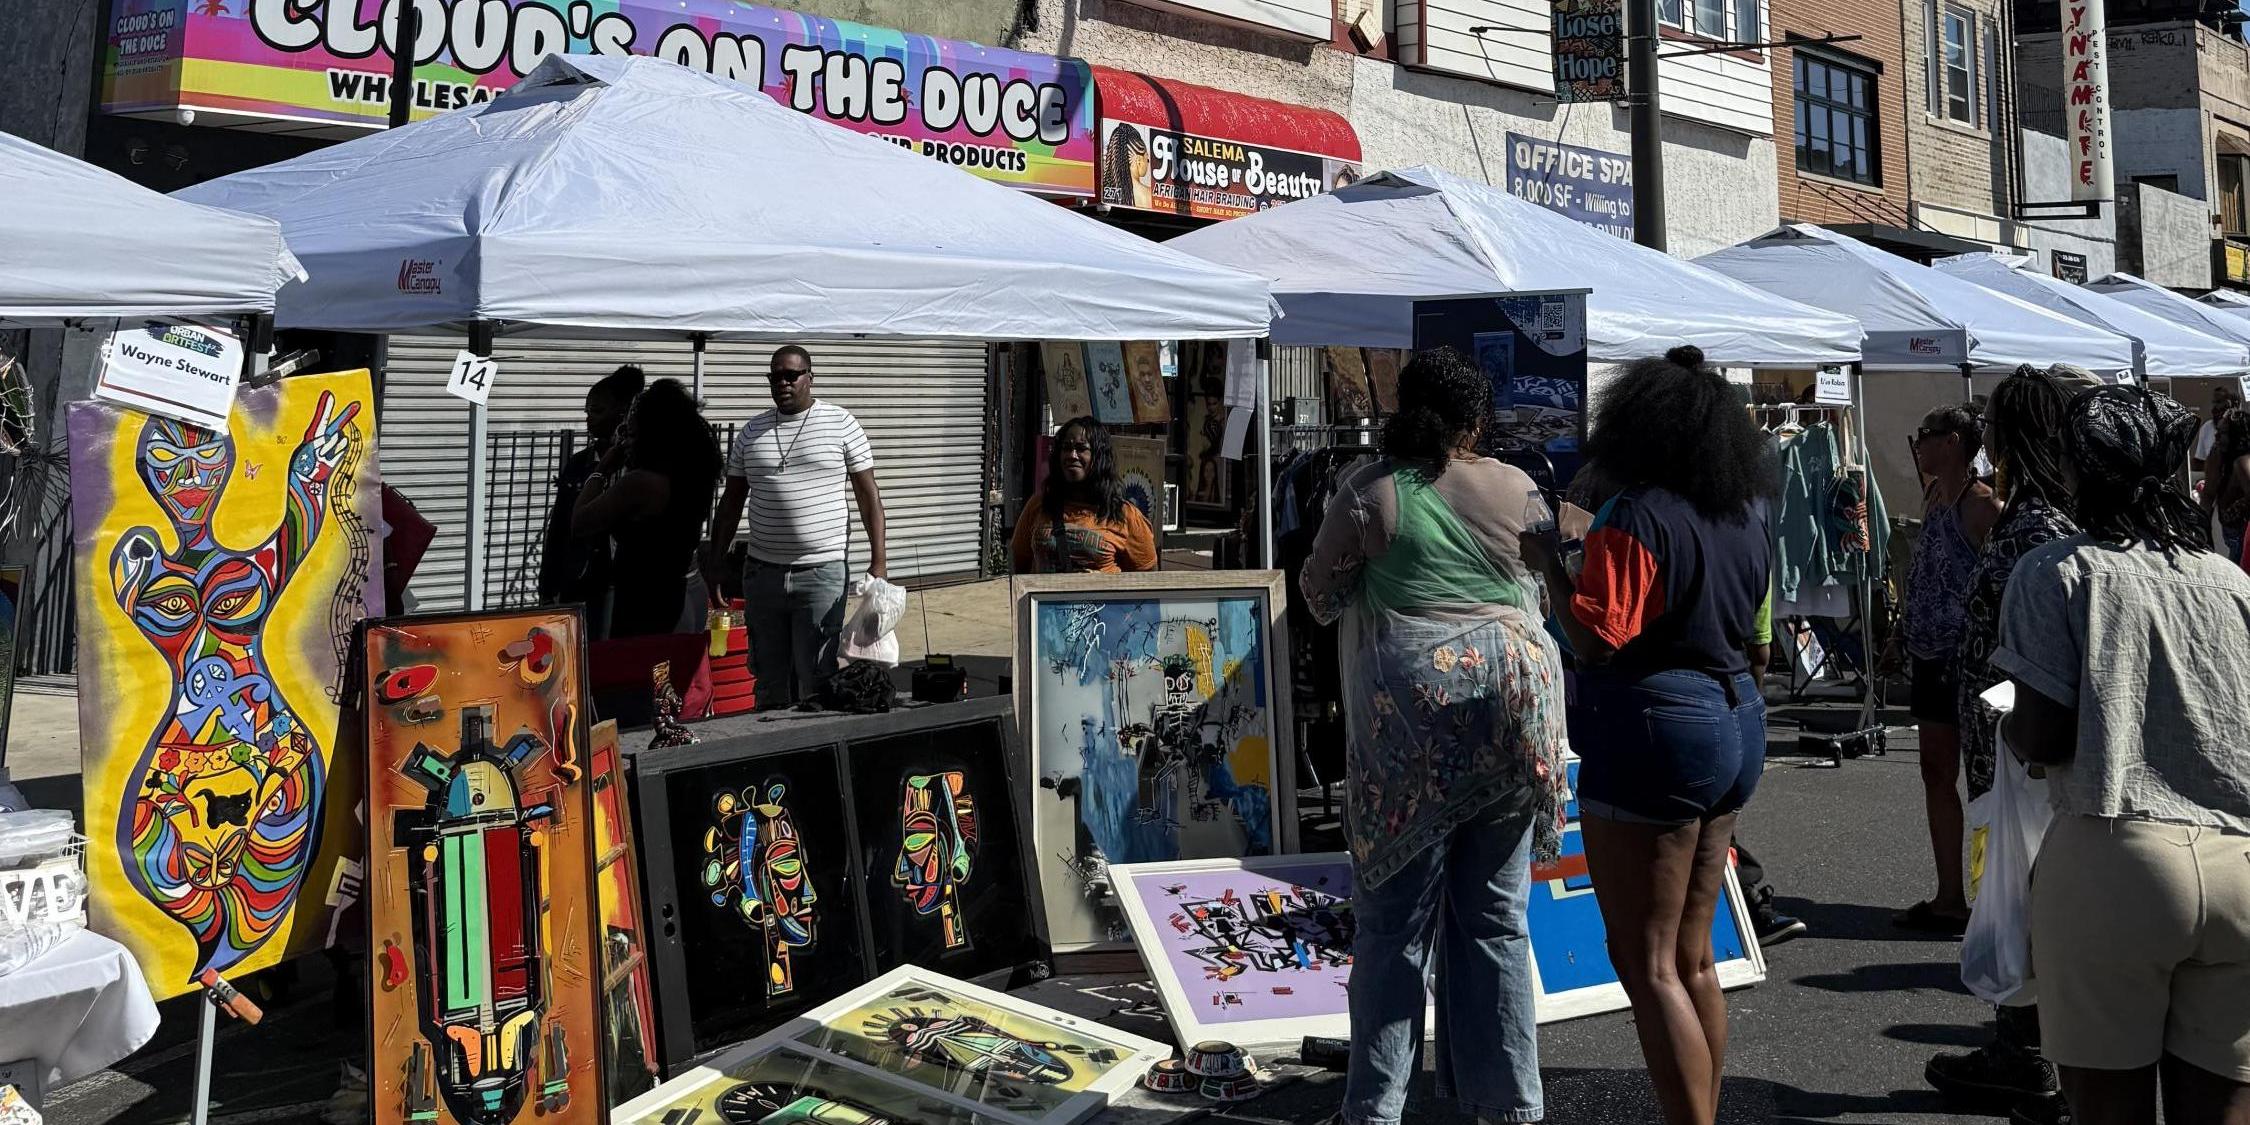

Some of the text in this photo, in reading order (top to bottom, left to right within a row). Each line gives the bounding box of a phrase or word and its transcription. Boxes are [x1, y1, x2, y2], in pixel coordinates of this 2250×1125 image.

[117, 10, 175, 34] CLOUD'S ON
[1557, 13, 1615, 39] Lose
[120, 33, 166, 55] THE DUCE
[2092, 30, 2100, 70] PEST
[250, 0, 637, 78] CLOUD'S
[780, 43, 909, 125] THE
[921, 64, 1069, 145] DUCE
[1558, 54, 1616, 84] Hope
[330, 72, 506, 110] WHLESA
[2069, 0, 2094, 184] YNAMITE
[2095, 85, 2105, 159] CONTROL
[923, 141, 1026, 172] PRODUCTS
[1184, 138, 1245, 162] SALEMA
[1516, 142, 1633, 186] OFFICE SPA
[1152, 135, 1229, 188] House
[1245, 151, 1322, 199] Beauty
[1153, 182, 1256, 209] AFRICAN HAIR BRAIDING
[1554, 183, 1574, 208] SF
[1585, 192, 1617, 219] Willing
[1618, 198, 1630, 216] to
[398, 259, 434, 290] Master
[410, 276, 441, 294] Canopy
[170, 326, 206, 343] URBAN
[121, 343, 231, 386] Wayne Stewart
[459, 360, 487, 391] 14
[0, 872, 83, 926] VE
